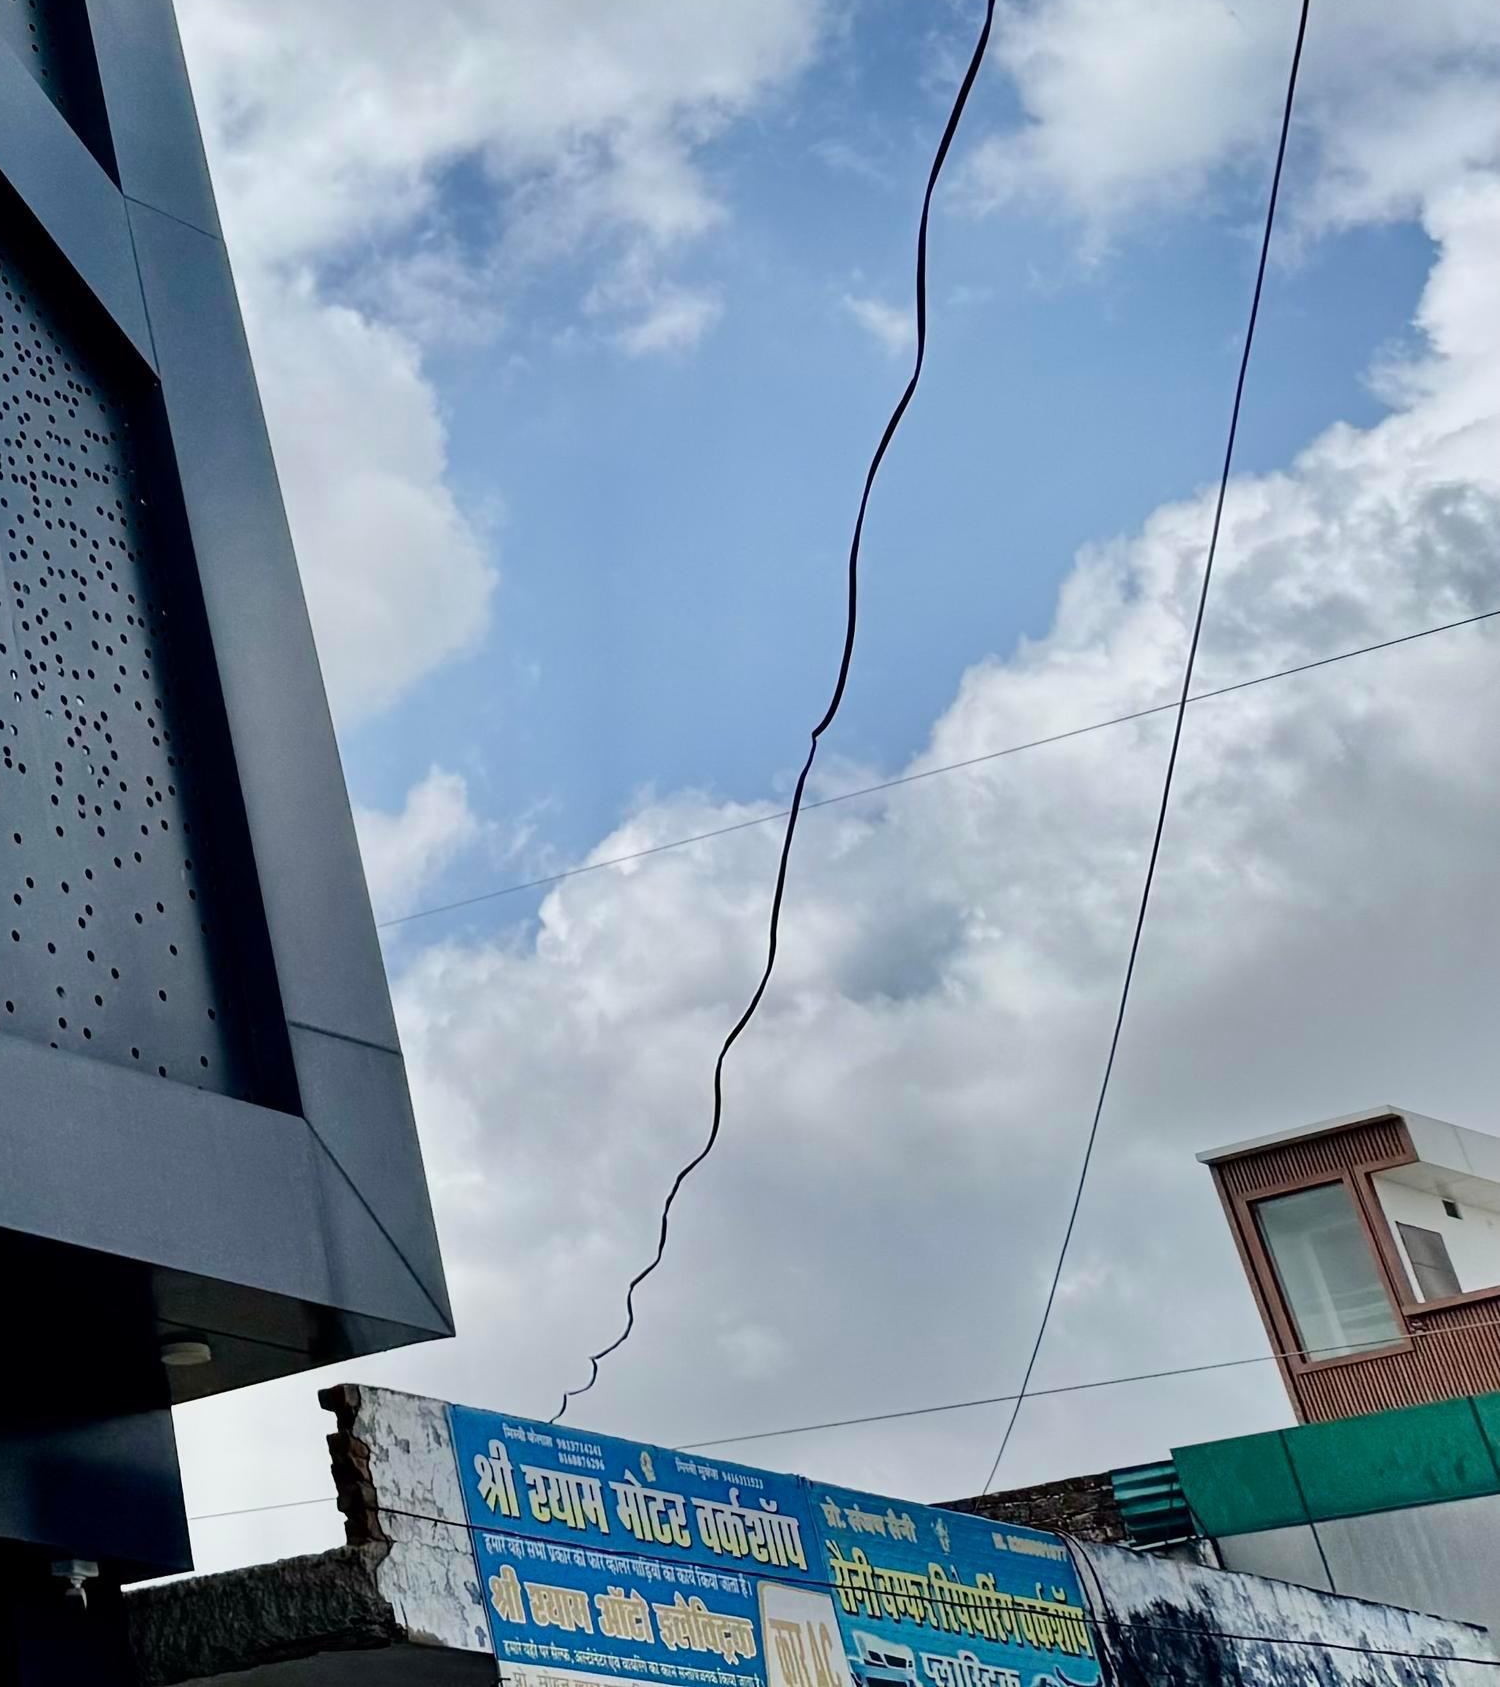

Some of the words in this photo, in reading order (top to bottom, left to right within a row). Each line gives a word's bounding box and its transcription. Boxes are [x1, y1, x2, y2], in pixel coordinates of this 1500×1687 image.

[473, 1439, 521, 1518] श्री
[520, 1464, 610, 1534] श्याम
[608, 1469, 691, 1548] मोटर
[690, 1487, 807, 1571] वर्कशॉप
[488, 1564, 526, 1624] श्री
[523, 1580, 594, 1635] श्याम
[1010, 1582, 1098, 1659] वर्कशॉप
